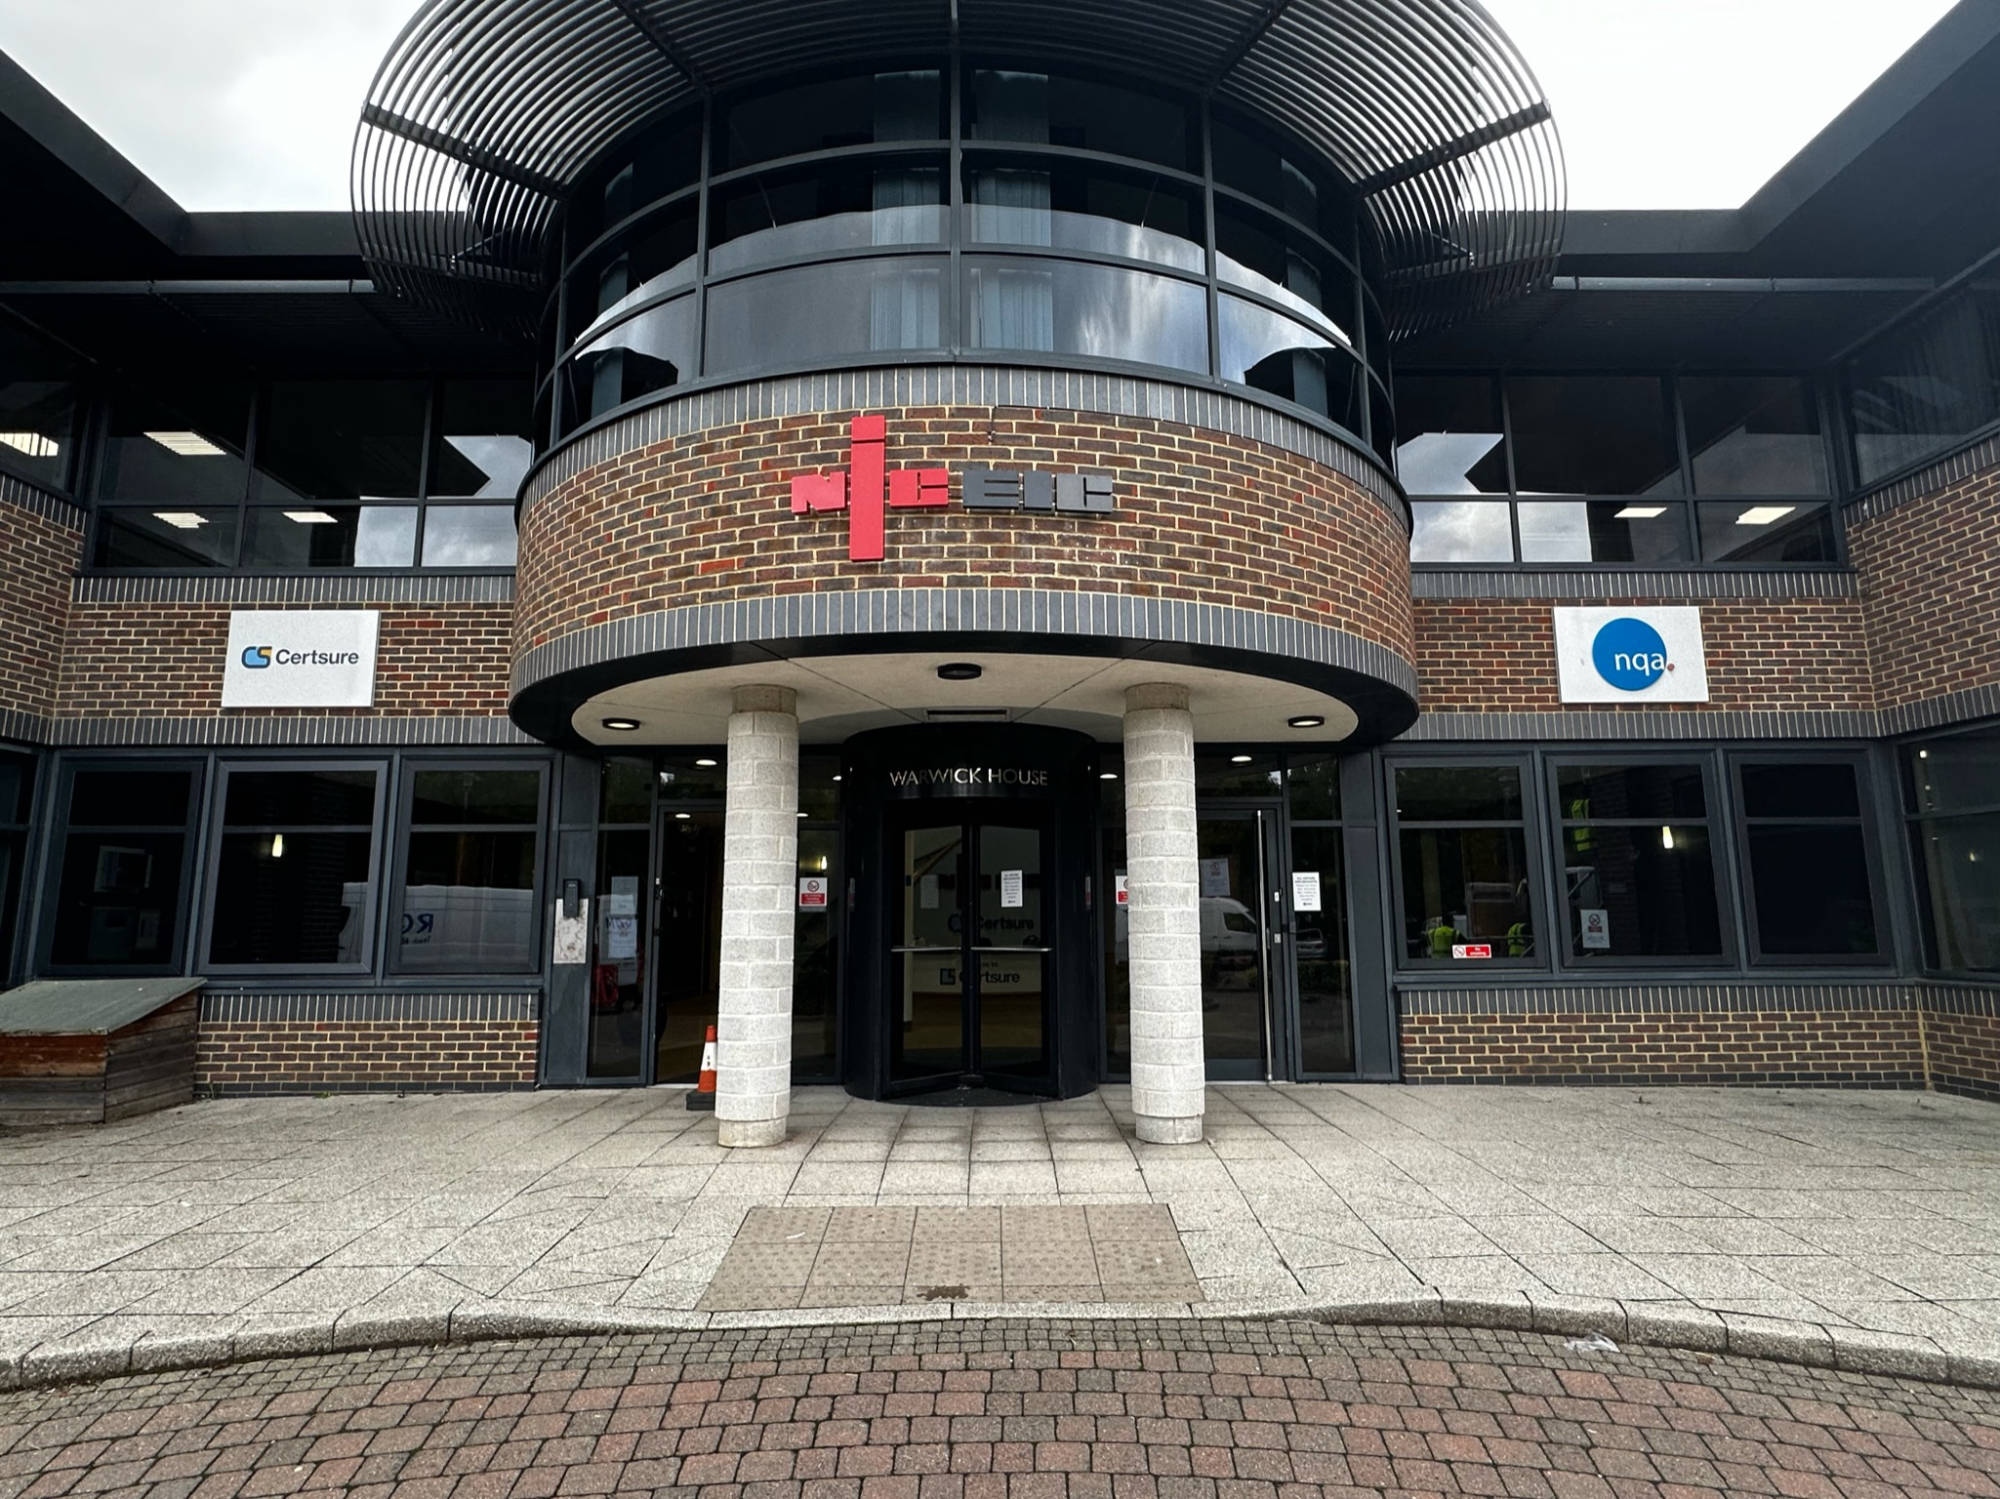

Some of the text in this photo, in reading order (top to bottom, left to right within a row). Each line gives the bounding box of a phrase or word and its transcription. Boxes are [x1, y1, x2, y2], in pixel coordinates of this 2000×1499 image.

[275, 649, 359, 665] Certsure
[889, 767, 1048, 787] WARWICK HOUSE
